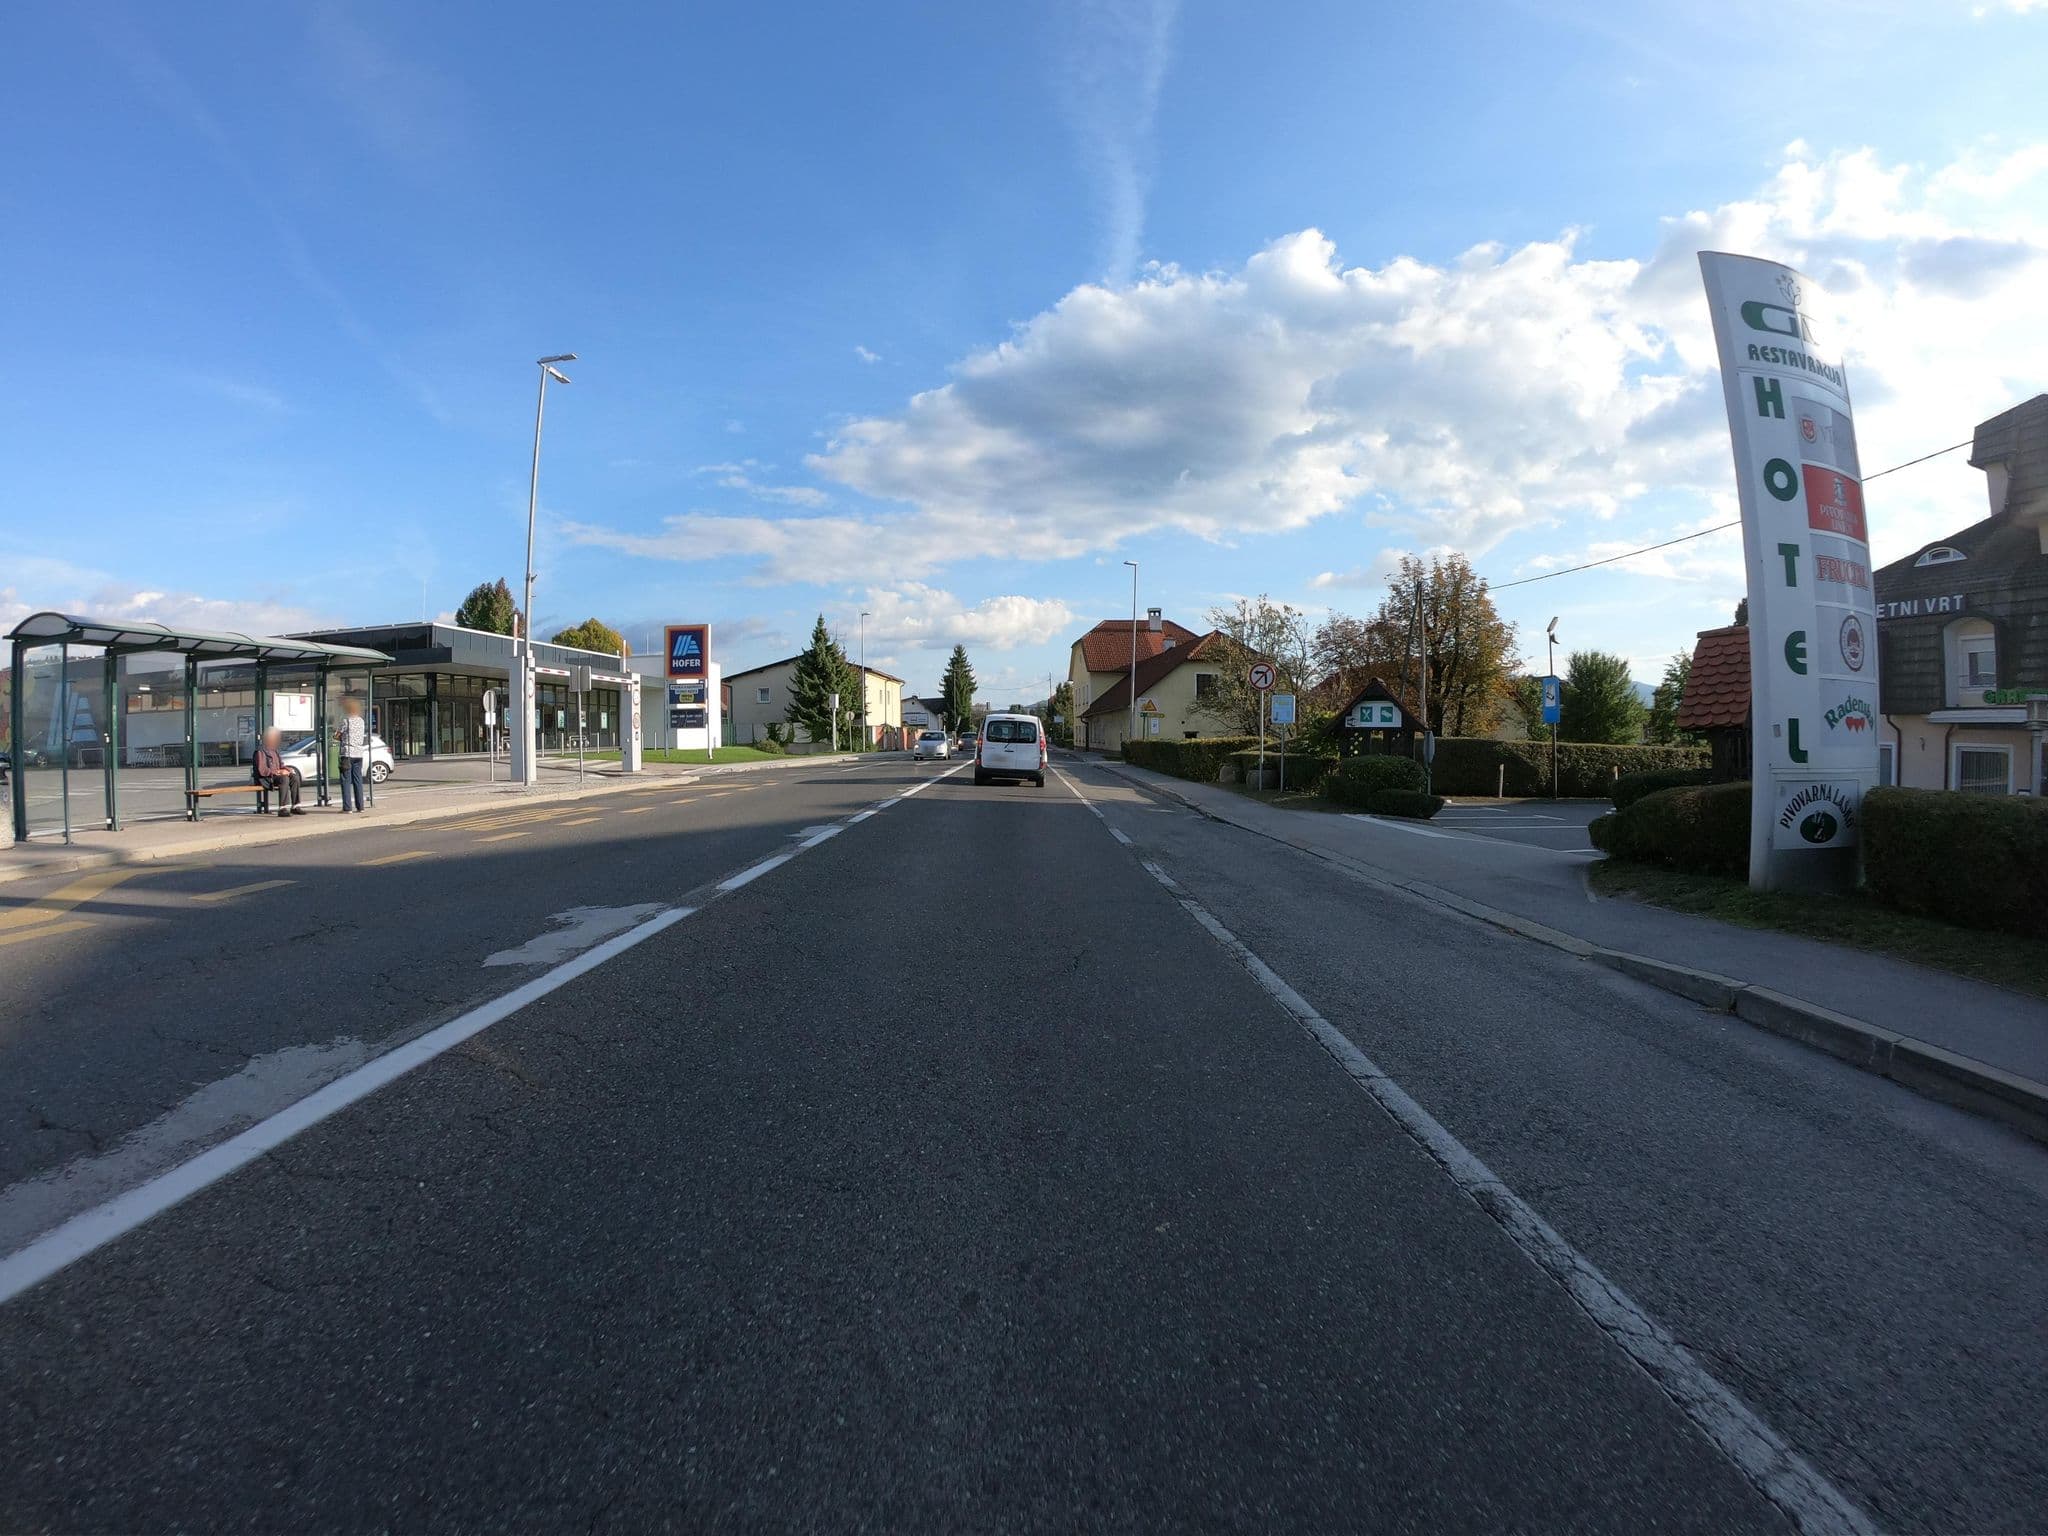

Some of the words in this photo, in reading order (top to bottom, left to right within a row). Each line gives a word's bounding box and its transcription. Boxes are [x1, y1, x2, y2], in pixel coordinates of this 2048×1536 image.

[1876, 600, 1918, 618] ETNI
[1924, 595, 1963, 612] VRT
[672, 659, 701, 667] HOFER
[1779, 784, 1832, 829] PIVOVARNA
